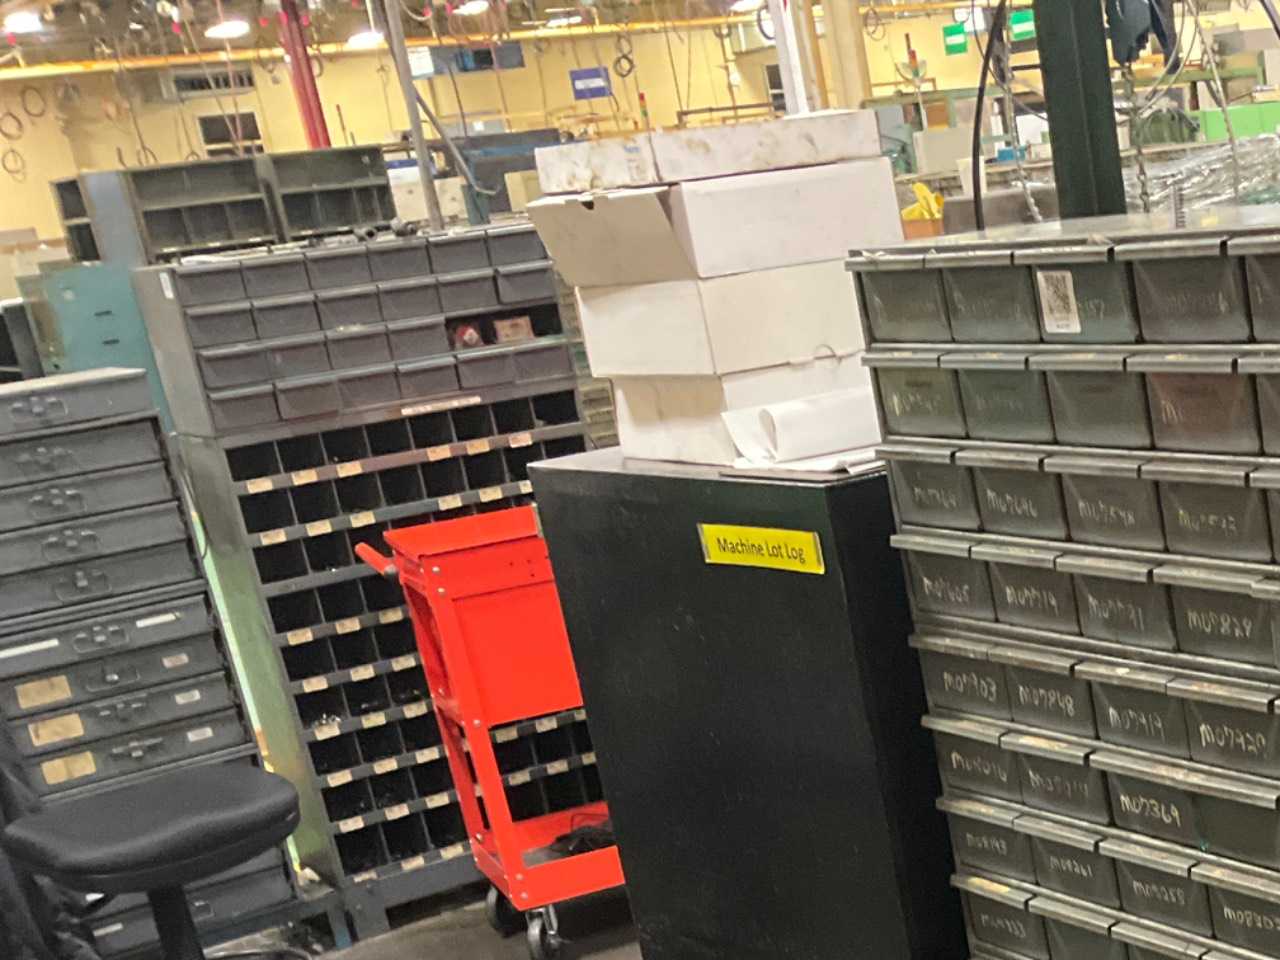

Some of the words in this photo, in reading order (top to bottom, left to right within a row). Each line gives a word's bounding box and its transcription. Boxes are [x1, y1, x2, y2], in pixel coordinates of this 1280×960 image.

[716, 536, 765, 557] Machine
[765, 540, 785, 559] Lot
[784, 543, 807, 565] Log
